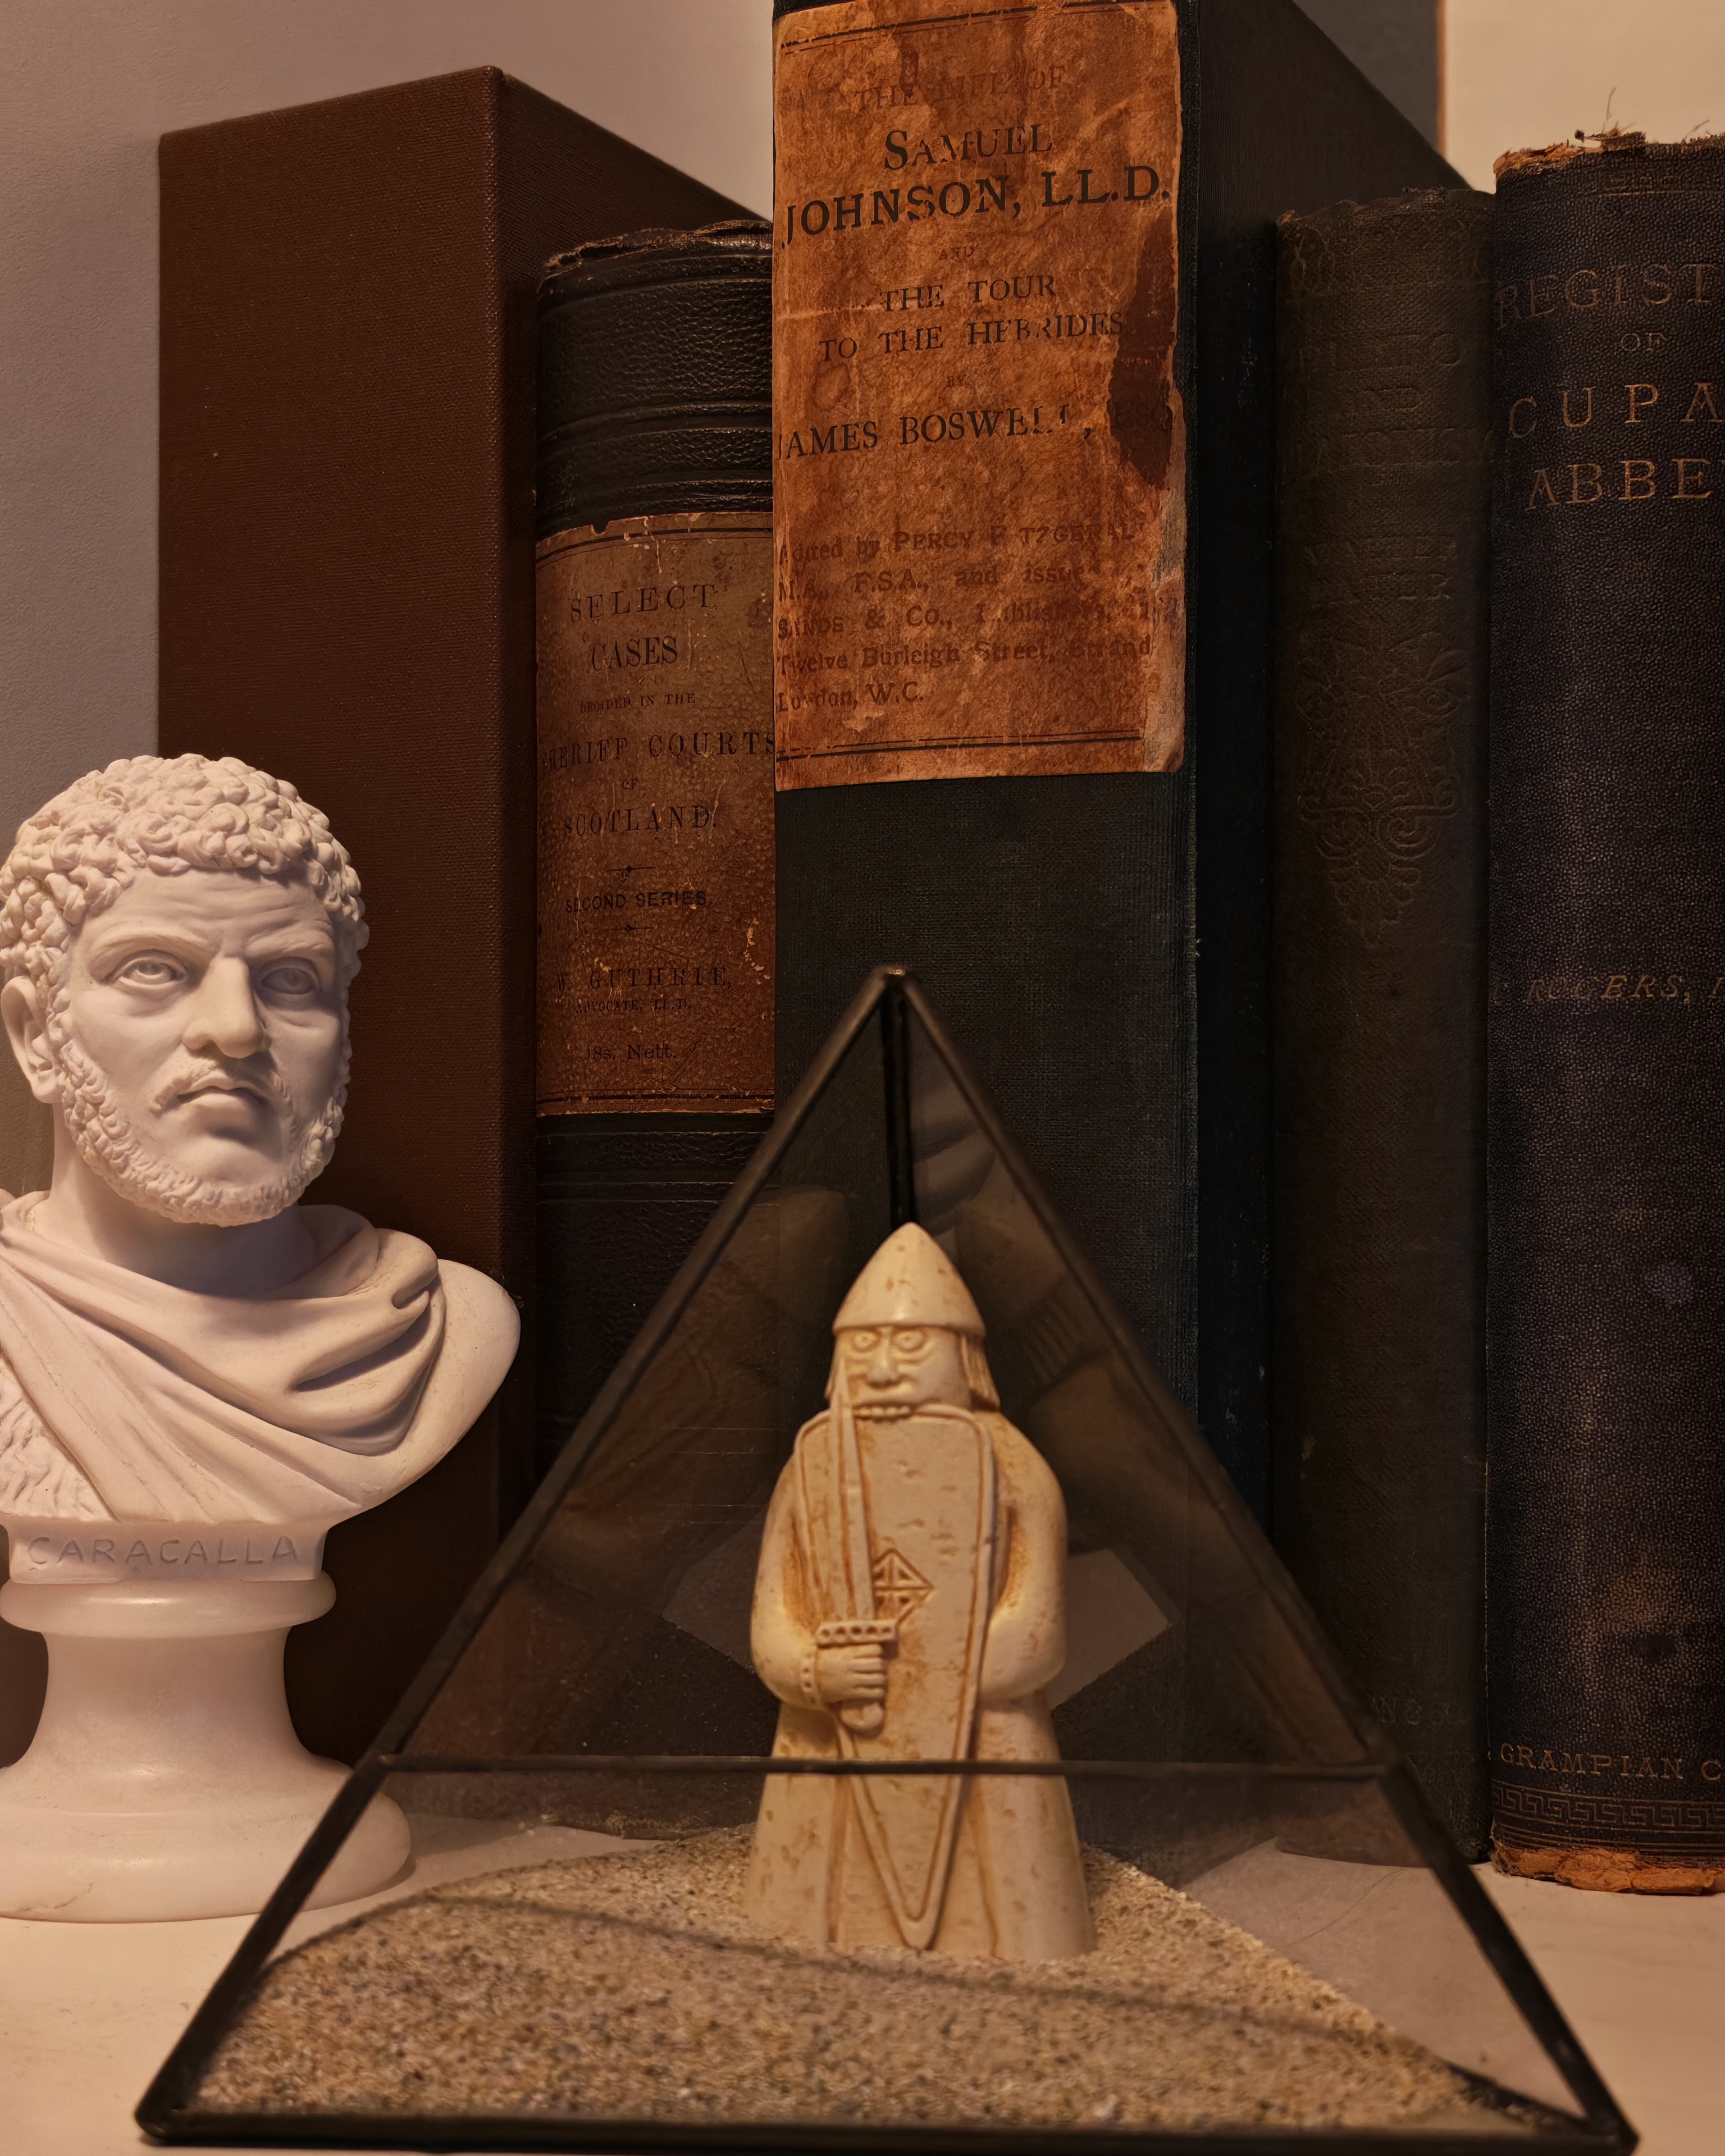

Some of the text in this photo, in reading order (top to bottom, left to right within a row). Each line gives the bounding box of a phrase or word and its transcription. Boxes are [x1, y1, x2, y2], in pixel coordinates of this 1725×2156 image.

[781, 164, 1171, 249] JOHNSON, LL.D.
[879, 273, 1056, 313] THE TOUR
[819, 336, 859, 363] TO
[877, 325, 944, 355] THE
[1620, 333, 1668, 351] OF
[1524, 458, 1725, 511] ABBE
[955, 563, 999, 587] and
[570, 584, 720, 622] SELECT
[864, 608, 885, 631] &
[592, 635, 679, 671] CASES
[861, 645, 960, 669] Burleigh
[640, 694, 656, 707] IN
[665, 692, 696, 705] THE
[777, 681, 924, 714] Lodon, W.C.
[541, 737, 628, 772] HERIFF
[566, 894, 626, 913] SECOND
[627, 1043, 678, 1060] Nett.
[30, 1536, 300, 1565] CARACALLA
[1500, 1742, 1684, 1780] GRAMPIAN
